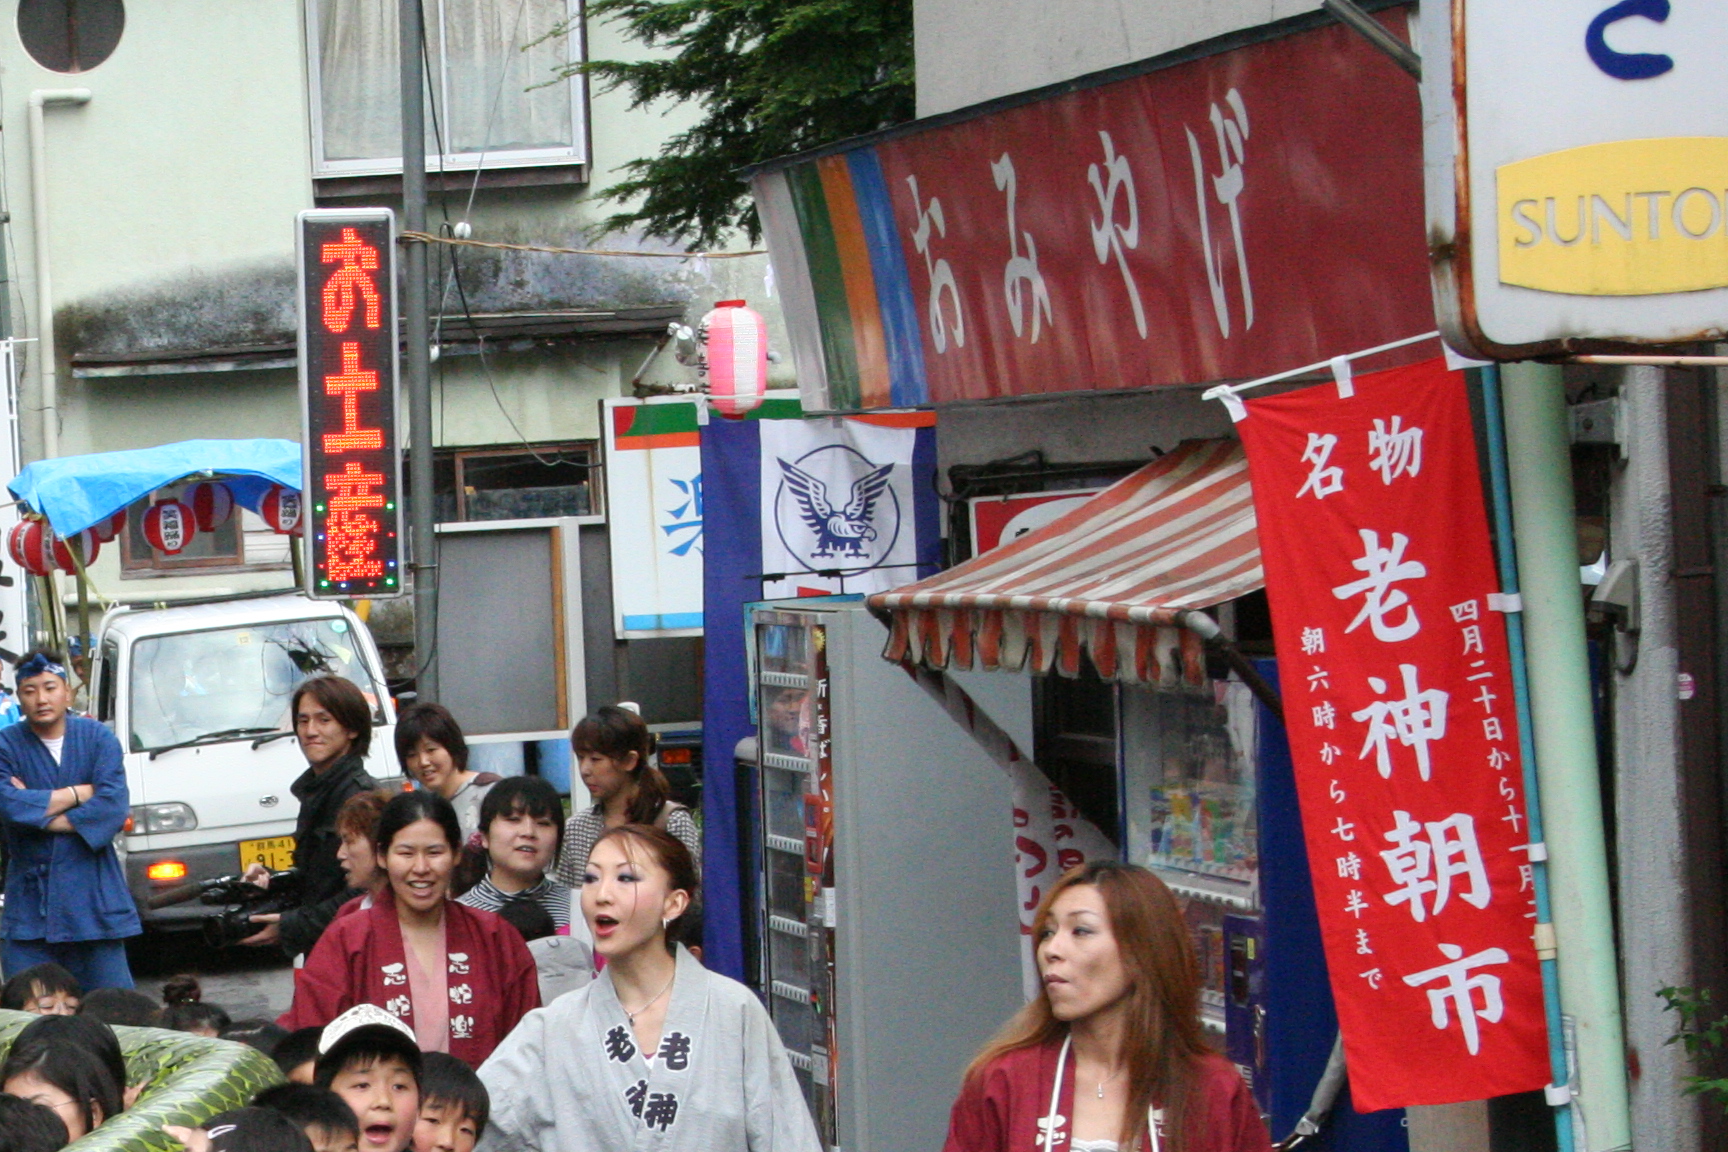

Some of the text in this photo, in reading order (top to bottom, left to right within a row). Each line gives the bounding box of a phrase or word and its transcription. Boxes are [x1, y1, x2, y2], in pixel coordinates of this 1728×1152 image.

[909, 86, 1252, 355] おみやげ
[1511, 186, 1728, 249] SUNTO
[1296, 414, 1425, 501] 名物
[1299, 626, 1383, 991] 朝六時から七時半まで
[1331, 527, 1511, 1057] 老神朝市
[643, 1031, 691, 1133] 老神
